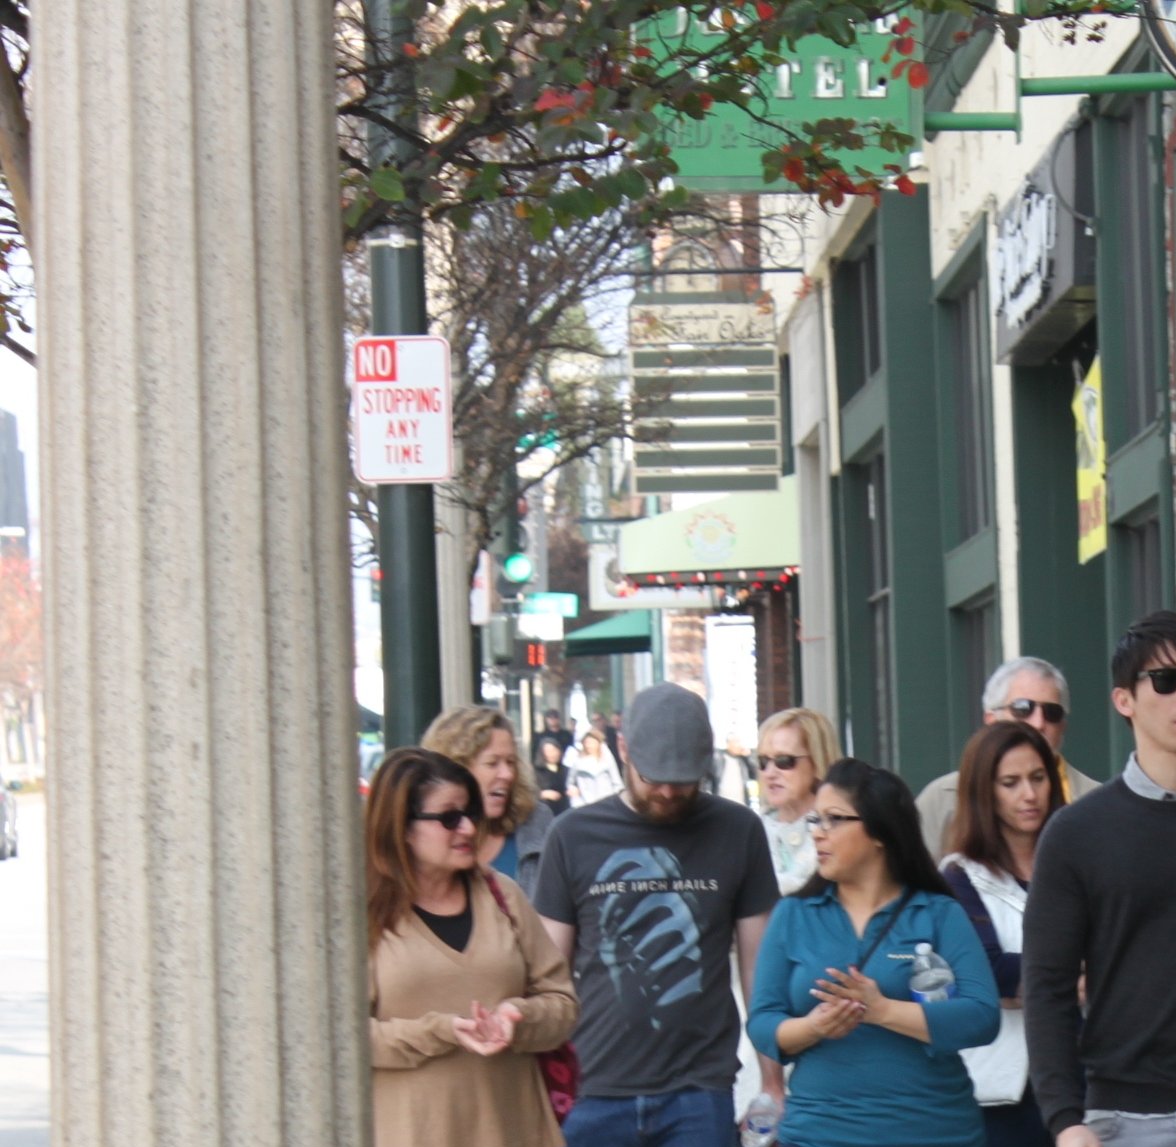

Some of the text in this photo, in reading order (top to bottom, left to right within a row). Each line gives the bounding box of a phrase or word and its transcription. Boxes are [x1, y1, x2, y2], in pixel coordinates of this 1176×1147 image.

[358, 344, 392, 377] NO
[363, 388, 441, 414] STOPPING
[386, 419, 420, 438] ANY
[384, 444, 423, 464] TIME
[589, 879, 719, 896] NINE INCH NAILS
